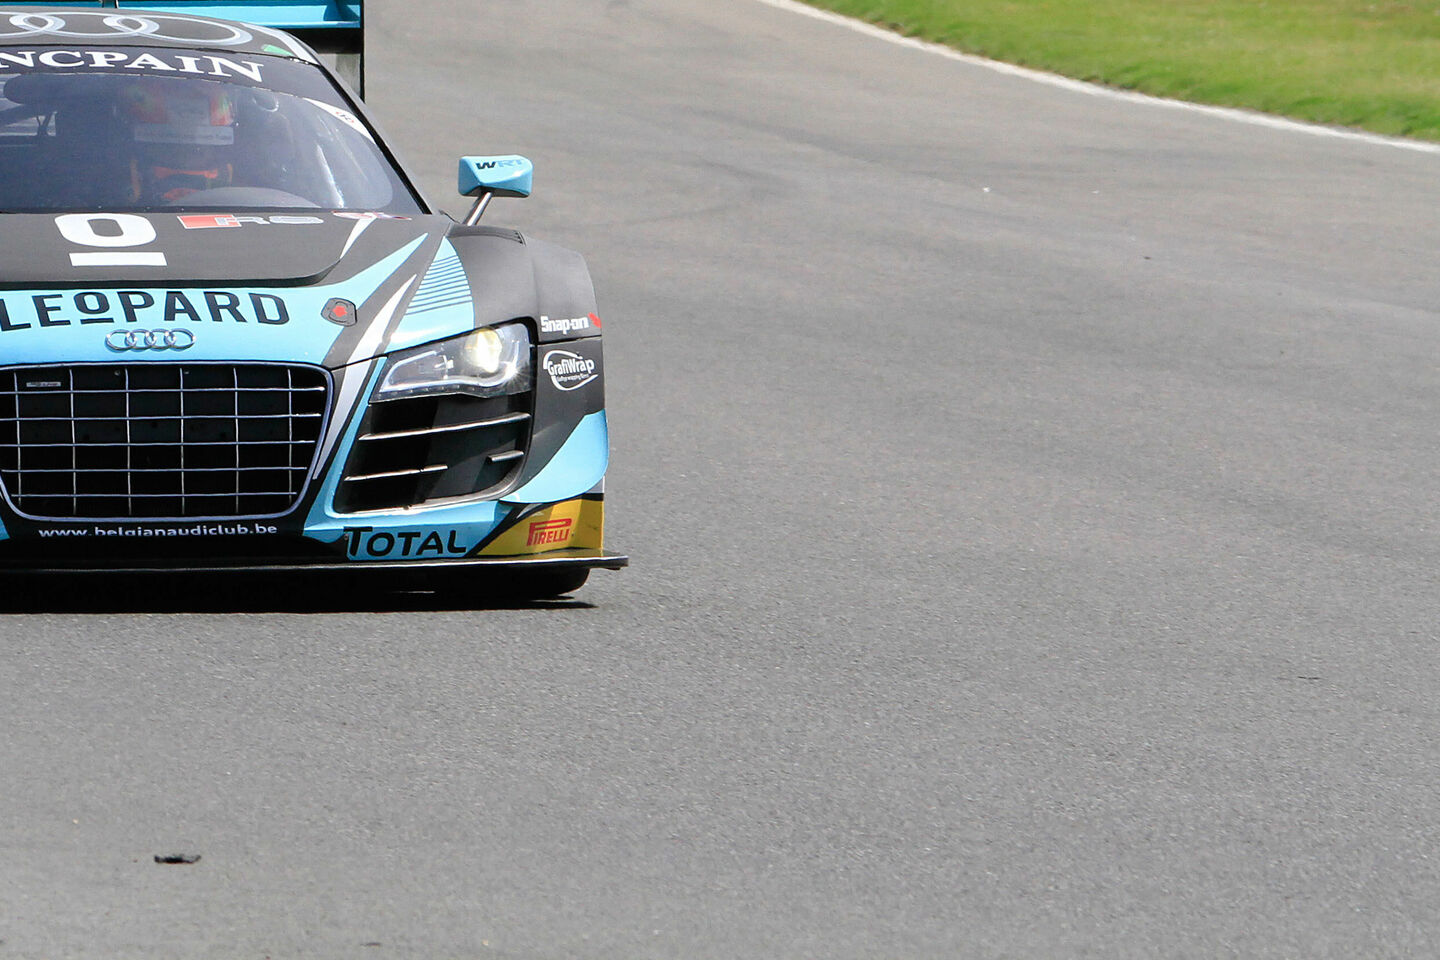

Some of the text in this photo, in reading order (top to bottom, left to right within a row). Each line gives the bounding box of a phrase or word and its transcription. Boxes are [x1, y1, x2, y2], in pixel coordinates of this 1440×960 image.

[540, 315, 590, 334] Snap-on
[547, 358, 595, 377] GrafiWrap
[38, 523, 278, 538] www.belgianaudiclub.be
[526, 518, 573, 546] PIRELLI
[343, 526, 467, 557] TOTAL
